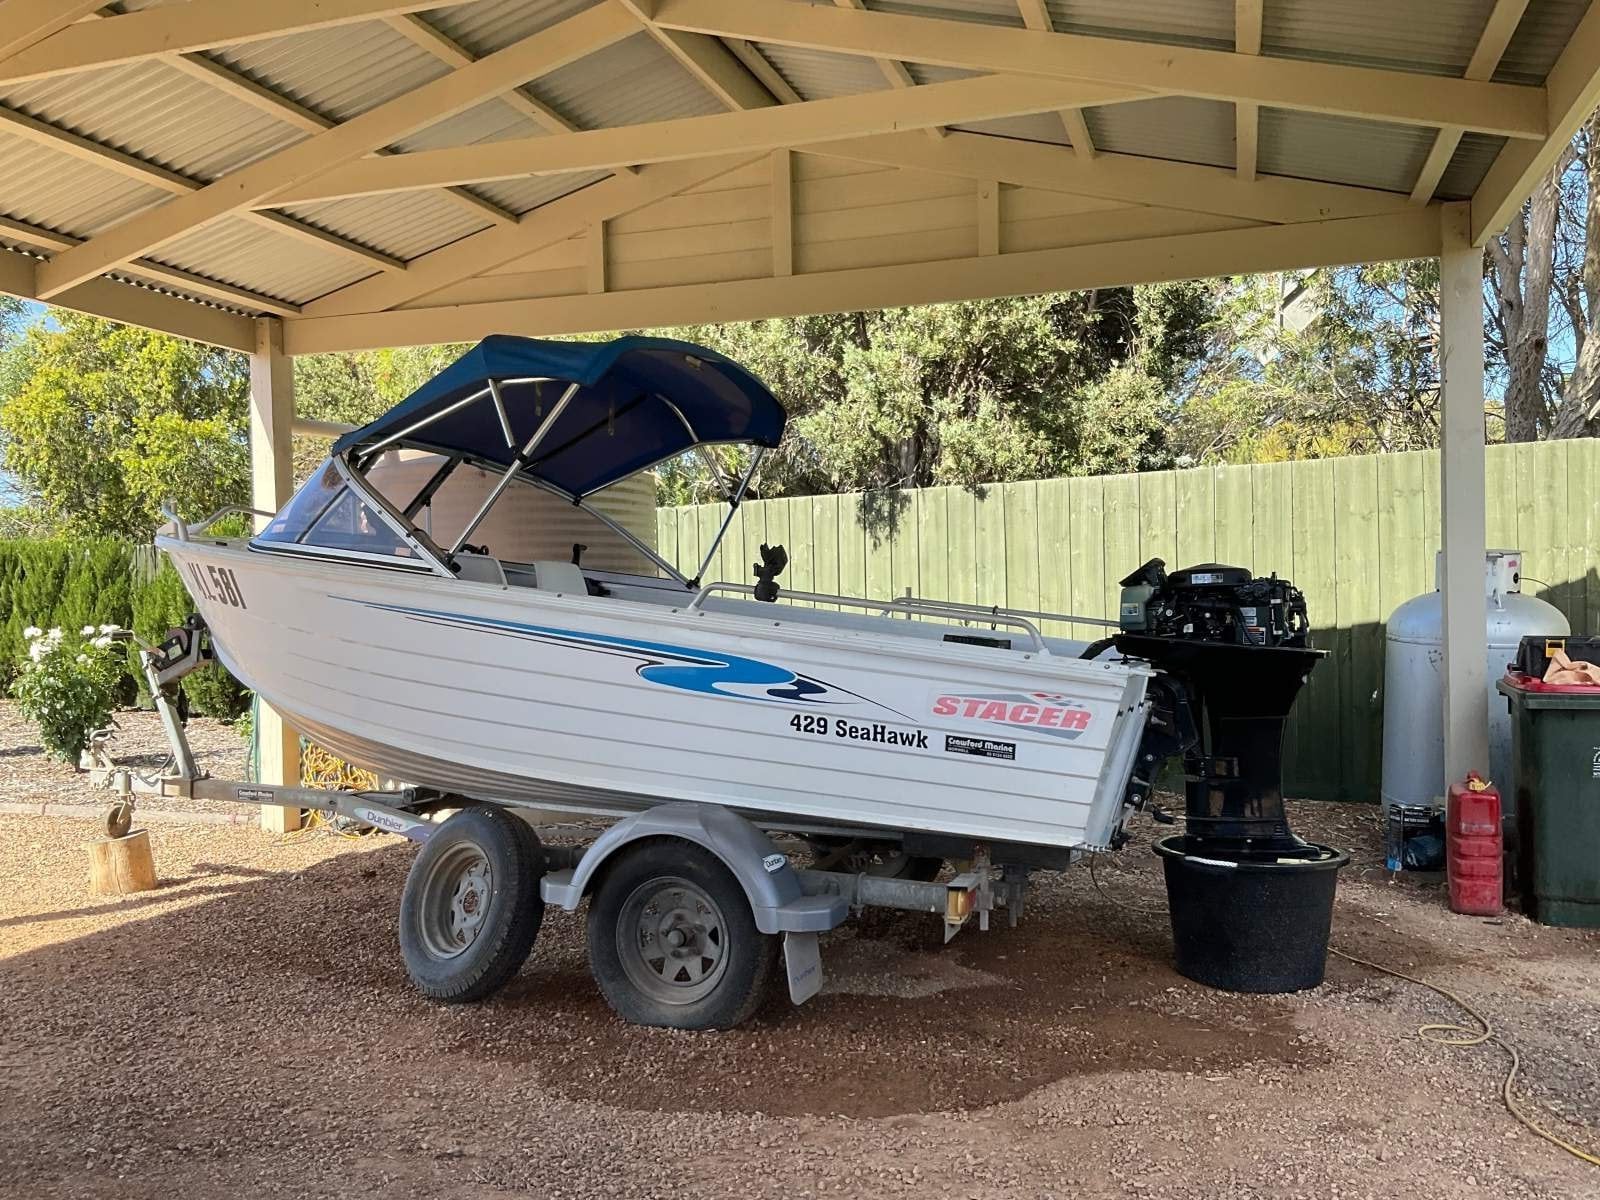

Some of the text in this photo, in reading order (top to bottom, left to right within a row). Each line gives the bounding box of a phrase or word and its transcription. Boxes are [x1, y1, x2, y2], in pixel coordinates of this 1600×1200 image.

[933, 696, 1092, 730] STACER
[789, 714, 928, 749] 429 SeaHawk
[947, 737, 1014, 753] Crawford Marine
[367, 810, 404, 831] Dunbier
